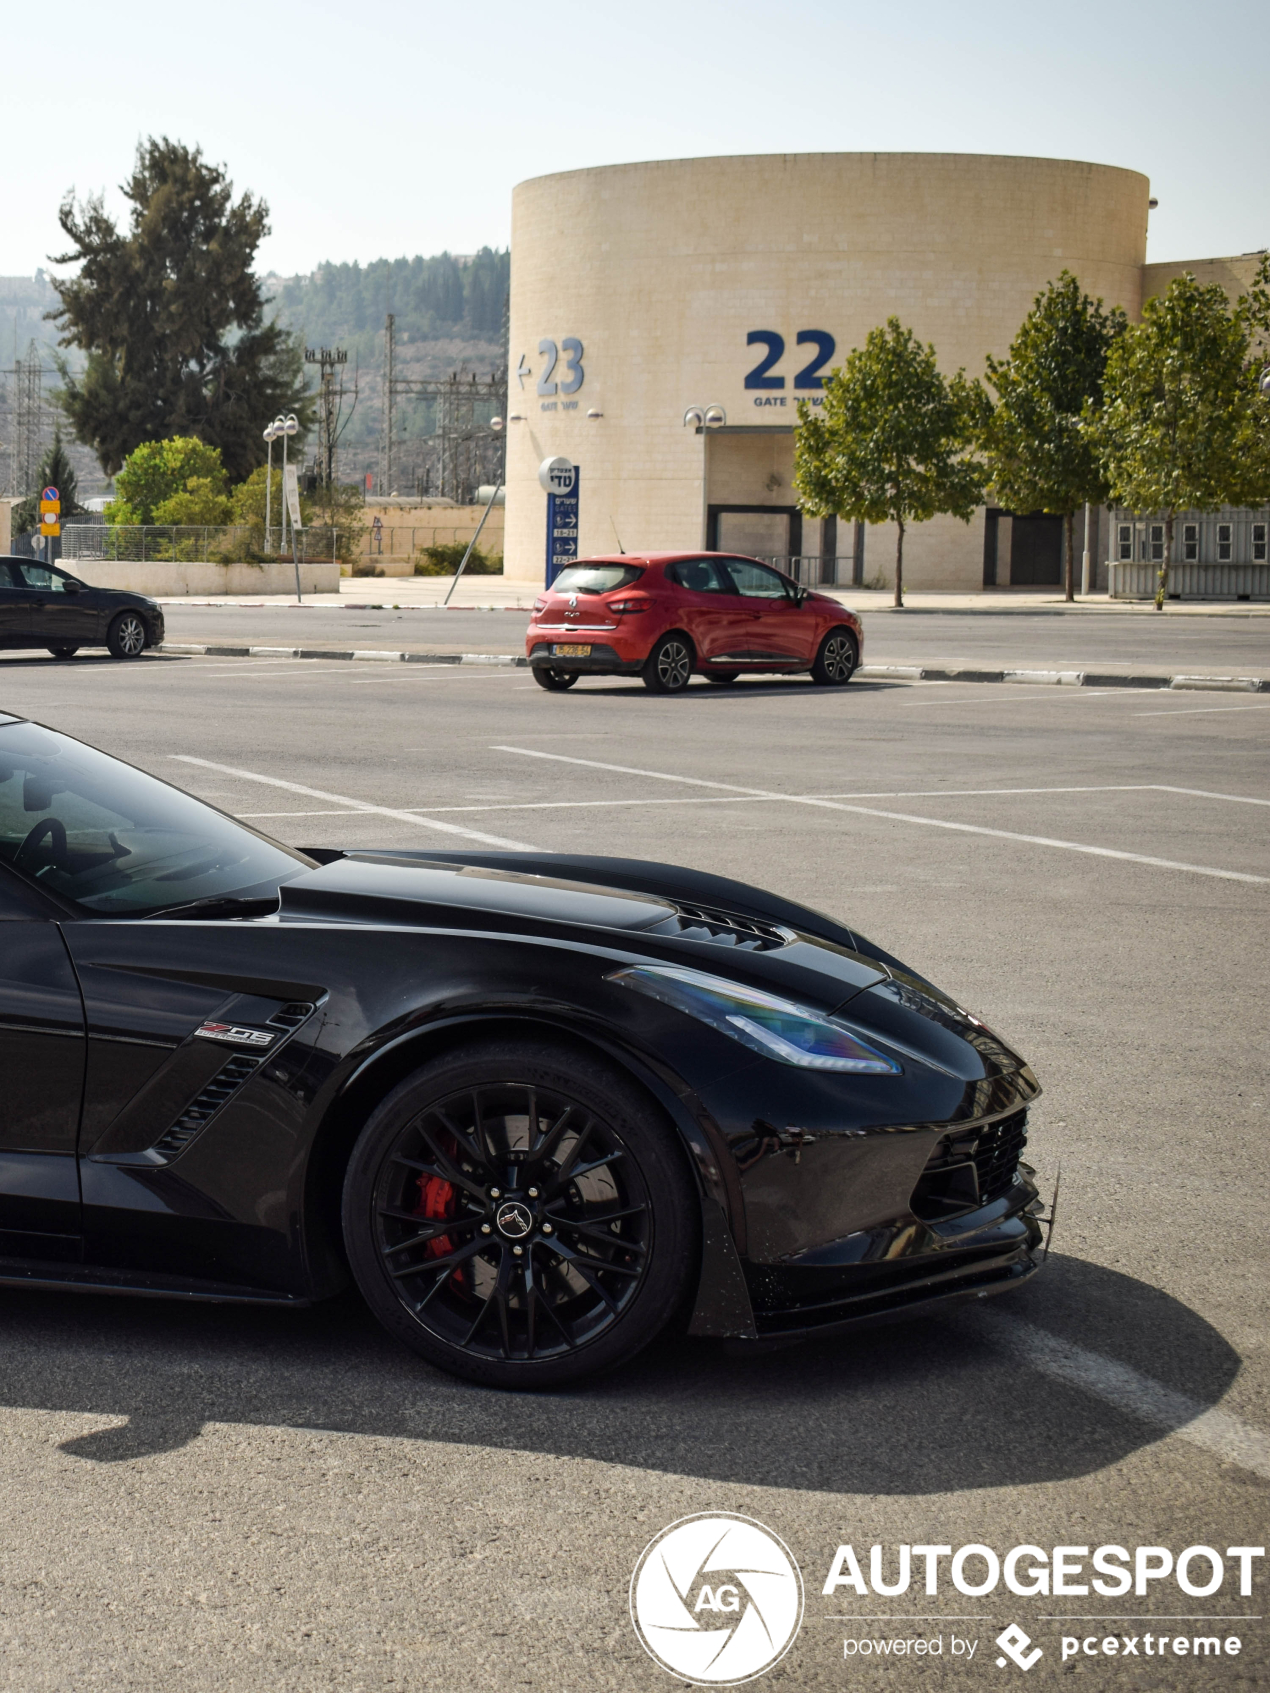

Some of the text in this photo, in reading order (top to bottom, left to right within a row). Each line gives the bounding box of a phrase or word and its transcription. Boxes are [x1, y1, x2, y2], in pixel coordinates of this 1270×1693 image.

[537, 337, 584, 396] 23
[744, 329, 836, 390] 22
[753, 397, 787, 407] GATE
[550, 475, 572, 488] טדי
[199, 1021, 275, 1042] Z06
